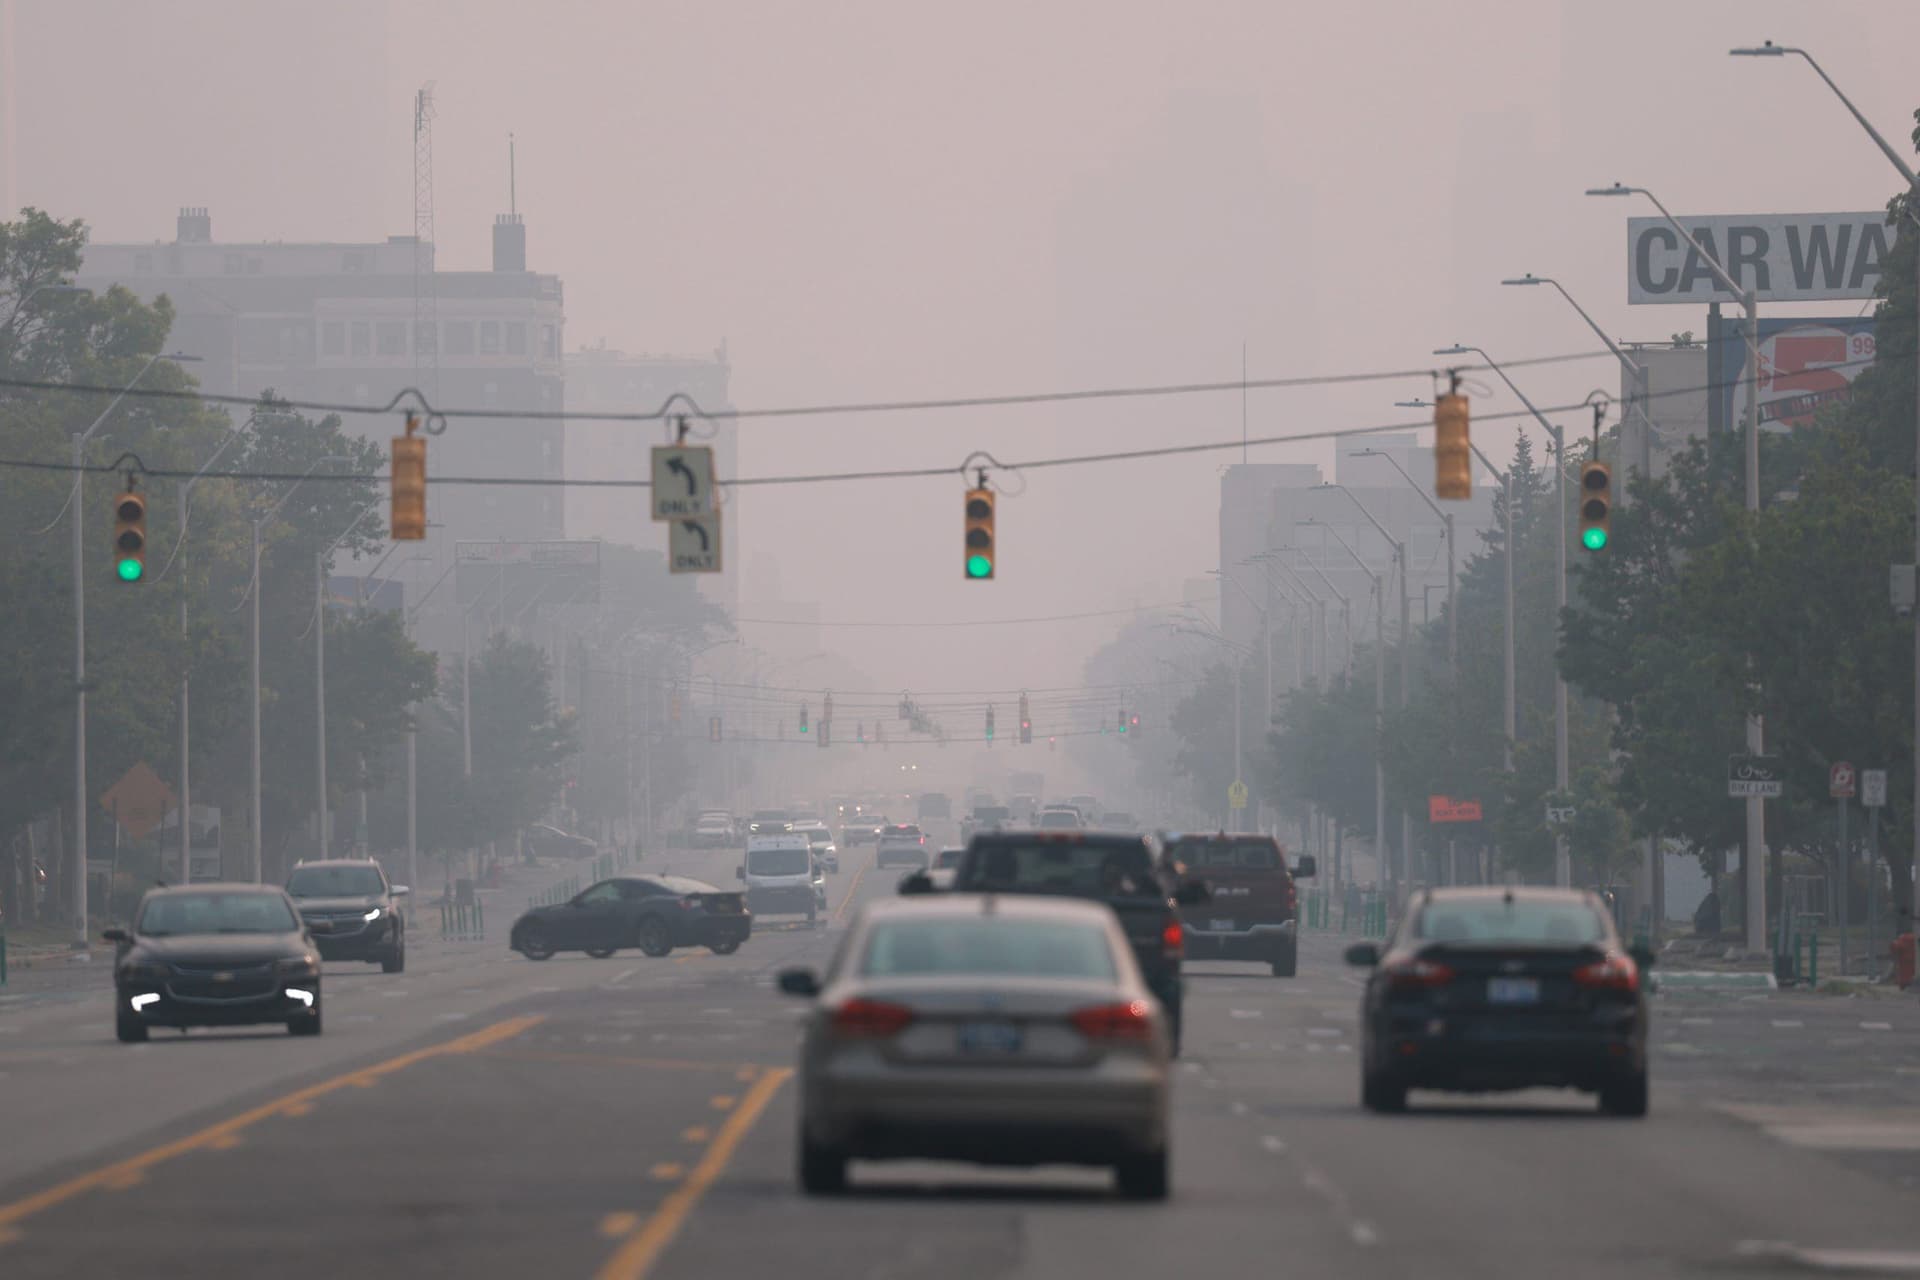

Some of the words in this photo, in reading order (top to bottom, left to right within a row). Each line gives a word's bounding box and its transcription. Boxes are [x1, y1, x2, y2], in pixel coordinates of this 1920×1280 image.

[1636, 226, 1770, 294] CAR
[660, 501, 701, 514] ONLY
[677, 556, 713, 567] ONLY
[1731, 782, 1751, 793] BIKE
[1754, 782, 1781, 793] LANE
